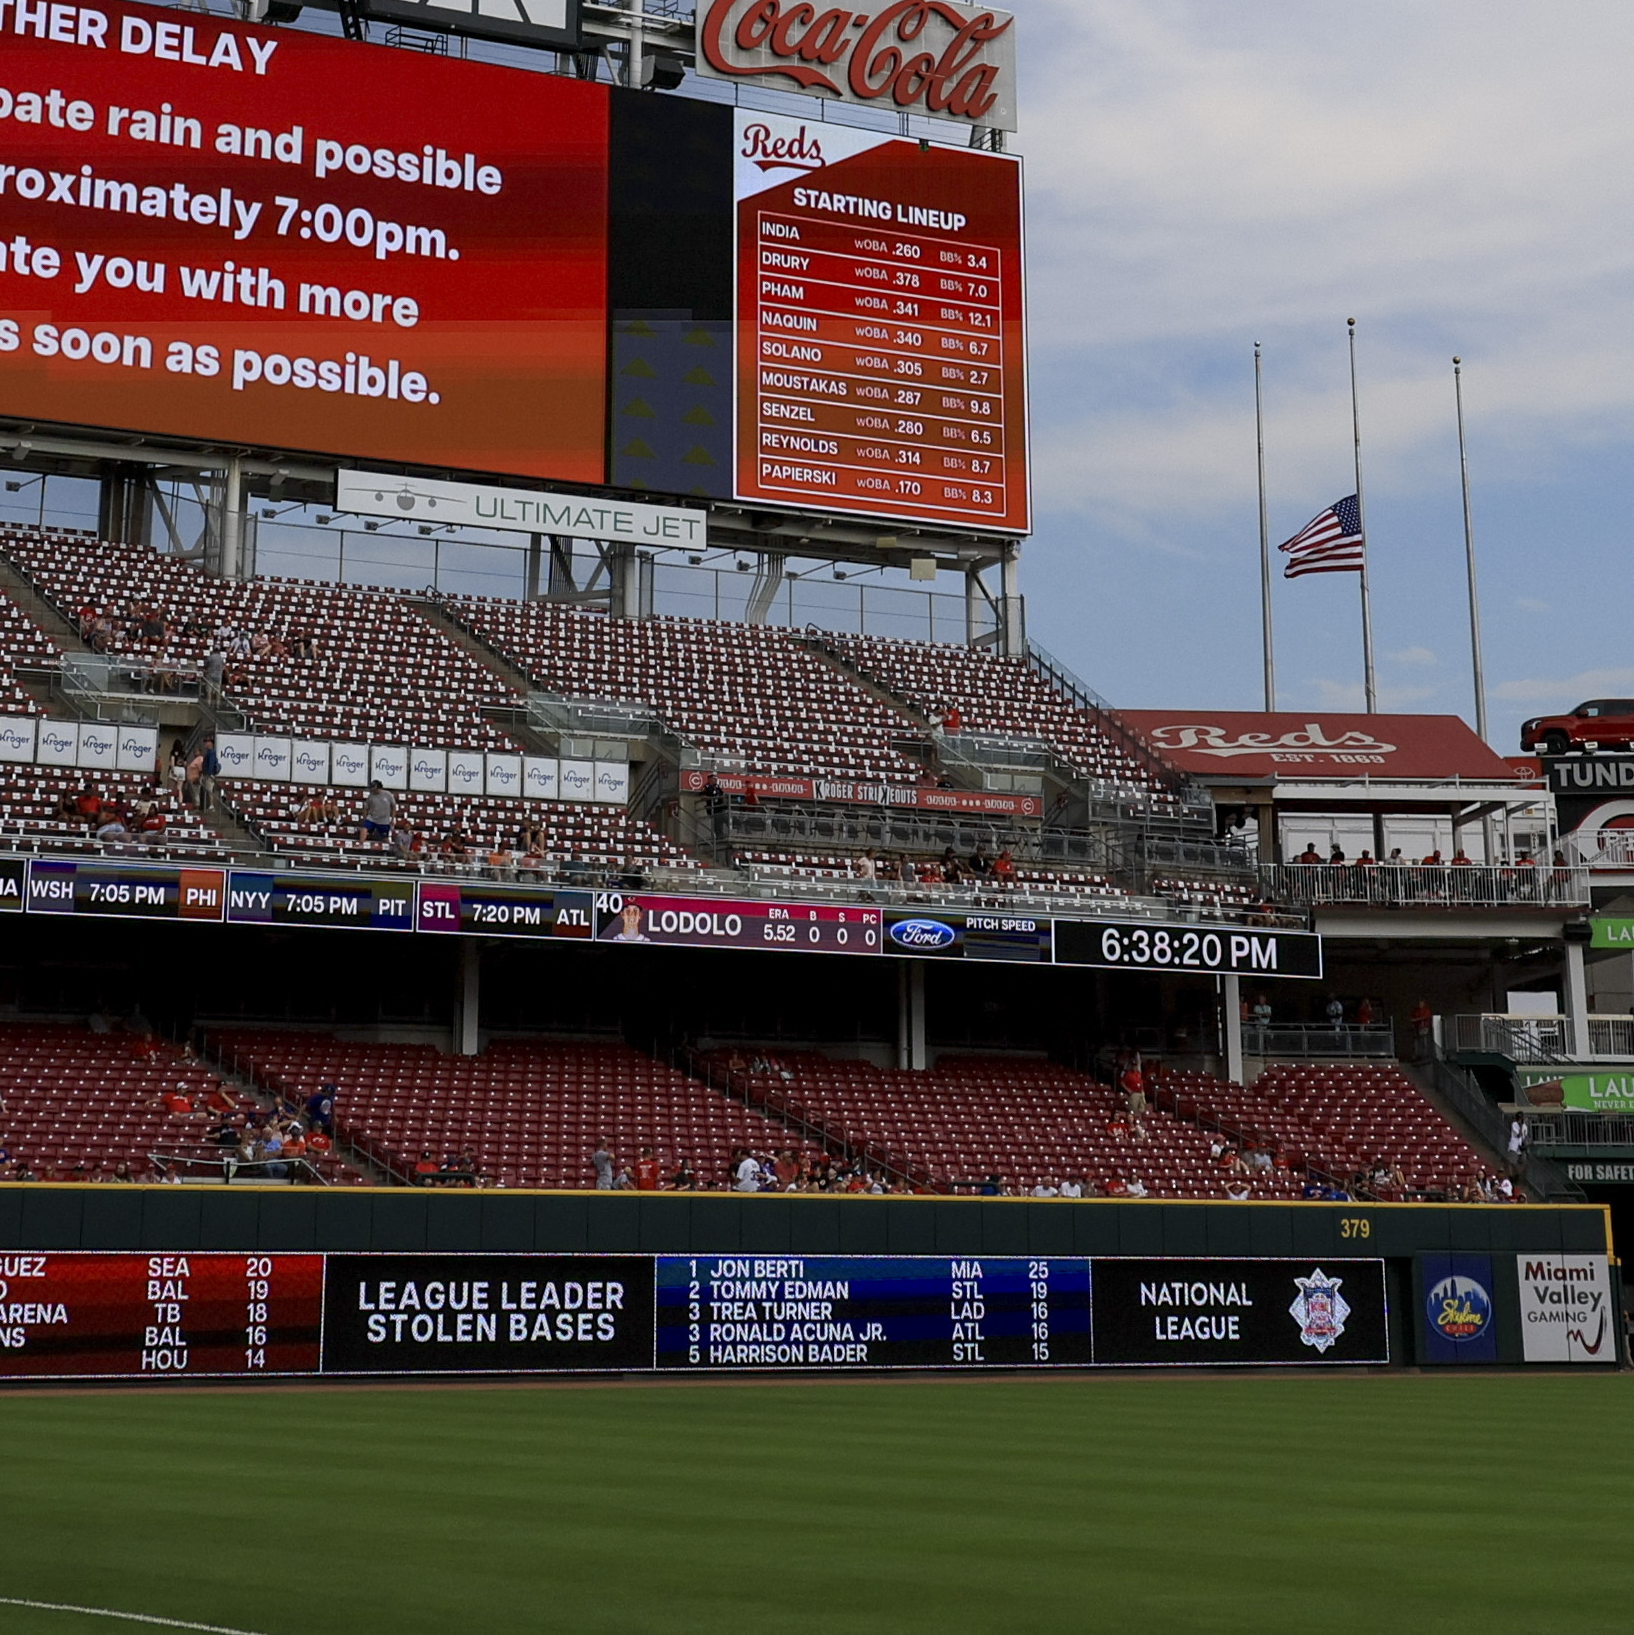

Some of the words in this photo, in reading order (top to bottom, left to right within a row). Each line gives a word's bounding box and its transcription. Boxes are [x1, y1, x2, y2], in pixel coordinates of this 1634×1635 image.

[120, 16, 278, 76] DELAY
[107, 100, 201, 149] rain
[215, 120, 302, 165] and
[314, 133, 502, 196] possible
[742, 123, 826, 172] Reds
[794, 188, 892, 220] STARTING
[897, 204, 966, 232] LINEUP
[274, 198, 461, 265] 7:00pm.
[762, 222, 800, 240] INDIA
[762, 252, 809, 271] DRURY
[75, 250, 164, 296] you
[179, 261, 285, 311] with
[298, 284, 419, 328] more
[762, 282, 804, 300] PHAM
[762, 312, 817, 332] NAQUIN
[762, 342, 821, 362] SOLANO
[33, 324, 152, 369] soon
[166, 338, 219, 377] as
[232, 346, 439, 406] possible.
[762, 372, 847, 396] MOUSTAKAS
[762, 403, 815, 422] SENZEL
[762, 433, 838, 455] REYNOLDS
[762, 464, 836, 485] PAPIERSKI
[475, 495, 633, 533] ULTIMATE
[643, 515, 701, 540] JET
[1151, 723, 1397, 758] Reds
[1270, 752, 1325, 764] EST.
[1330, 753, 1385, 765] 1869
[32, 881, 73, 899] WSH
[90, 883, 130, 902] 7:05
[135, 886, 164, 905] PM
[187, 888, 216, 907] PHI
[648, 911, 742, 936] LODOLO
[901, 922, 942, 945] Ford
[967, 918, 999, 931] PITCH
[1002, 919, 1036, 932] SPEED
[1102, 928, 1221, 967] 6:38:20
[1231, 936, 1277, 969] PM
[1594, 1100, 1626, 1110] NEVER
[1568, 1165, 1594, 1180] FOR
[1341, 1219, 1369, 1239] 379
[711, 1261, 749, 1277] JON
[754, 1261, 803, 1277] BERTI
[1524, 1261, 1594, 1281] Miami
[359, 1282, 488, 1309] LEAGUE
[502, 1282, 623, 1309] LEADER
[711, 1282, 777, 1299] TOMMY
[785, 1282, 848, 1299] EDMAN
[1141, 1282, 1252, 1306] NATIONAL
[1533, 1286, 1603, 1310] Valley
[711, 1303, 757, 1319] TREA
[763, 1303, 832, 1320] TURNER
[1438, 1300, 1483, 1325] Skyline
[1528, 1311, 1588, 1323] GAMING
[367, 1314, 495, 1342] STOLEN
[510, 1314, 615, 1342] BASES
[711, 1324, 785, 1341] RONALD
[791, 1324, 855, 1341] ACUNA
[860, 1324, 887, 1342] JR.
[1156, 1316, 1240, 1340] LEAGUE
[711, 1345, 804, 1363] HARRISON
[809, 1345, 867, 1363] BADER
